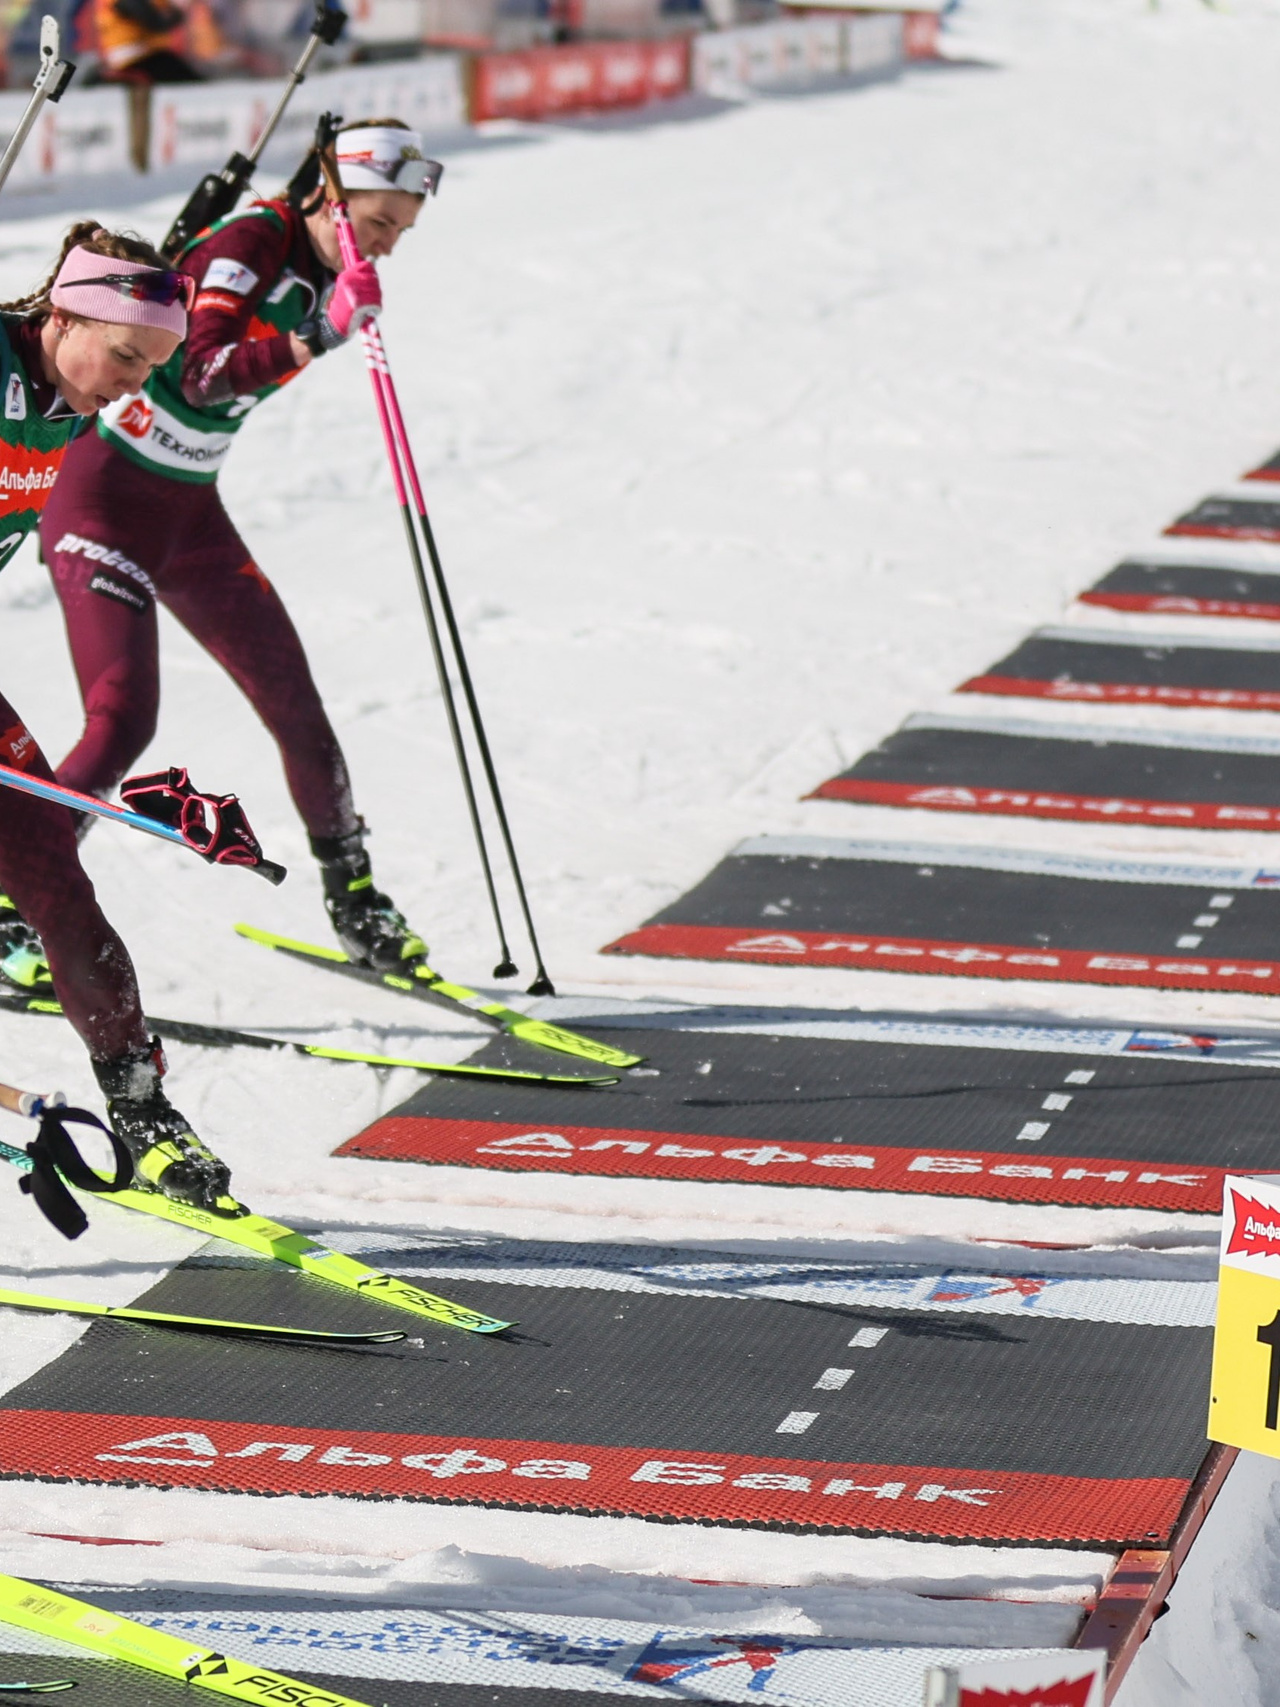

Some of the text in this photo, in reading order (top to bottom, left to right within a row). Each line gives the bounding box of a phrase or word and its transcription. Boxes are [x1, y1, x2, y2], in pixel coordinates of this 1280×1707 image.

[726, 934, 1060, 967] Альфа
[477, 1132, 1210, 1189] Альфа Банк
[167, 1204, 212, 1225] FISCHER
[387, 1288, 496, 1330] FISCHER
[94, 1431, 1005, 1508] Альфа Банк
